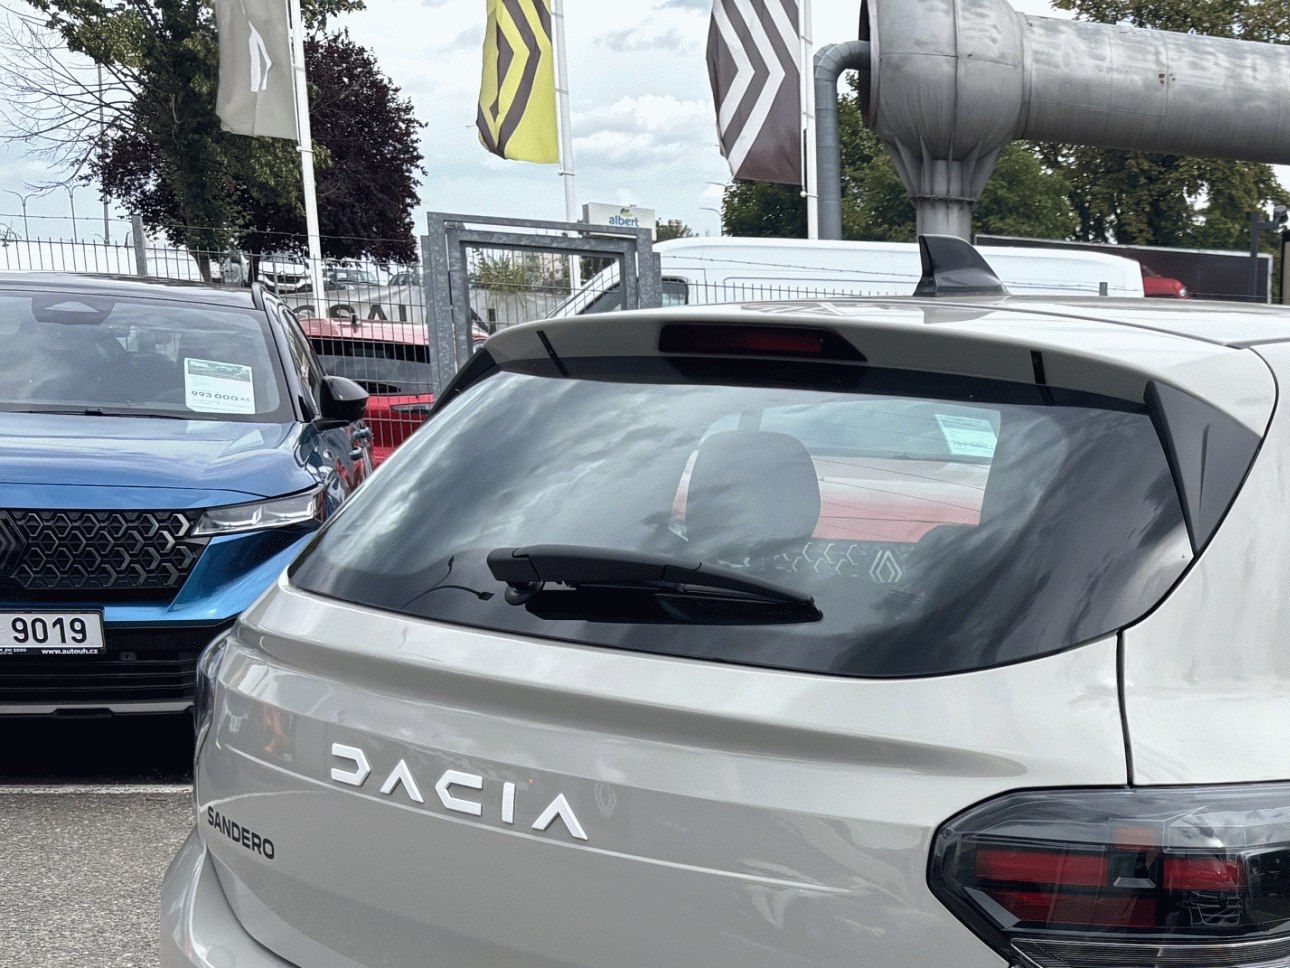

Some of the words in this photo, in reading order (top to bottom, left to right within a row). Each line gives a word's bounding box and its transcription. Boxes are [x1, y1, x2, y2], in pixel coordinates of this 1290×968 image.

[609, 215, 639, 227] albert
[11, 617, 87, 644] 9019
[330, 742, 589, 841] DACIA
[207, 805, 275, 860] SANDERO
